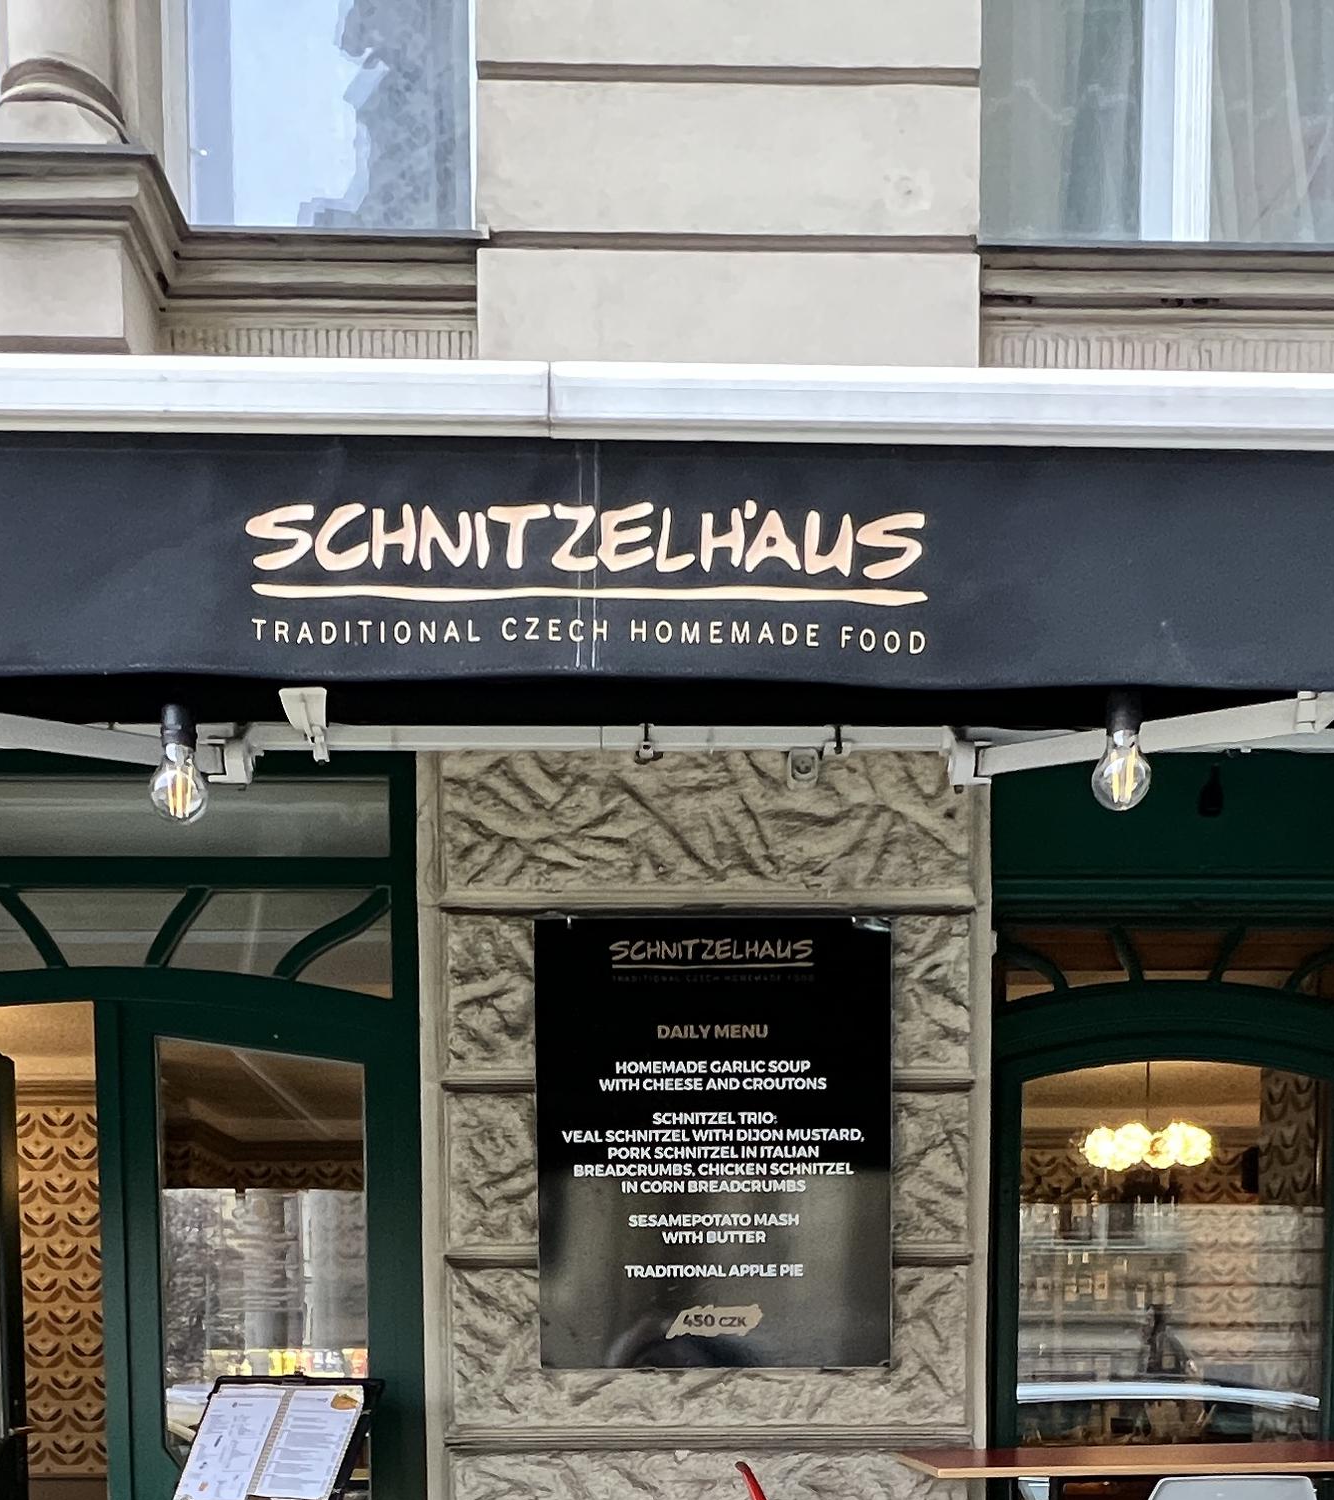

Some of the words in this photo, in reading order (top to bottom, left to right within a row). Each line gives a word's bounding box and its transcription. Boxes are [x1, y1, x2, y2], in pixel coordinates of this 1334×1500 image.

[251, 617, 483, 646] TRADITIONAL
[500, 616, 612, 645] CZECH
[627, 618, 822, 647] HOMEMADE
[839, 625, 929, 657] FOOD
[609, 938, 814, 962] SCHNITZELHAUS
[657, 1024, 712, 1040] DAILY
[714, 1024, 768, 1039] MENU
[615, 1060, 708, 1074] HOMEMADE
[710, 1060, 766, 1074] GARLIC
[768, 1060, 811, 1074] SOUP
[599, 1078, 640, 1091] WITH
[642, 1077, 703, 1091] CHEESE
[705, 1077, 740, 1090] AND
[742, 1077, 827, 1090] CROUTONS
[652, 1112, 736, 1125] SCHNITZEL
[561, 1129, 603, 1143] VEAL
[605, 1129, 690, 1143] SCHNITZEL
[692, 1129, 733, 1142] WITH
[736, 1129, 784, 1142] DIJON
[607, 1147, 651, 1160] PORK
[654, 1146, 738, 1159] SCHNITZEL
[741, 1146, 756, 1159] IN
[758, 1146, 819, 1159] ITALIAN
[698, 1163, 767, 1177] CHICKEN
[770, 1163, 854, 1176] SCHNITZEL
[621, 1181, 638, 1194] IN
[640, 1180, 685, 1194] CORN
[687, 1180, 806, 1194] BREADCRUMBS
[628, 1214, 752, 1228] SESAMEPOTATO
[753, 1214, 799, 1227] MASH
[662, 1231, 704, 1245] WITH
[706, 1231, 766, 1244] BUTTER
[624, 1265, 726, 1278] TRADITIONAL
[728, 1264, 777, 1278] APPLE
[779, 1264, 804, 1277] PIE
[682, 1314, 715, 1328] 450
[718, 1315, 747, 1328] CZK
